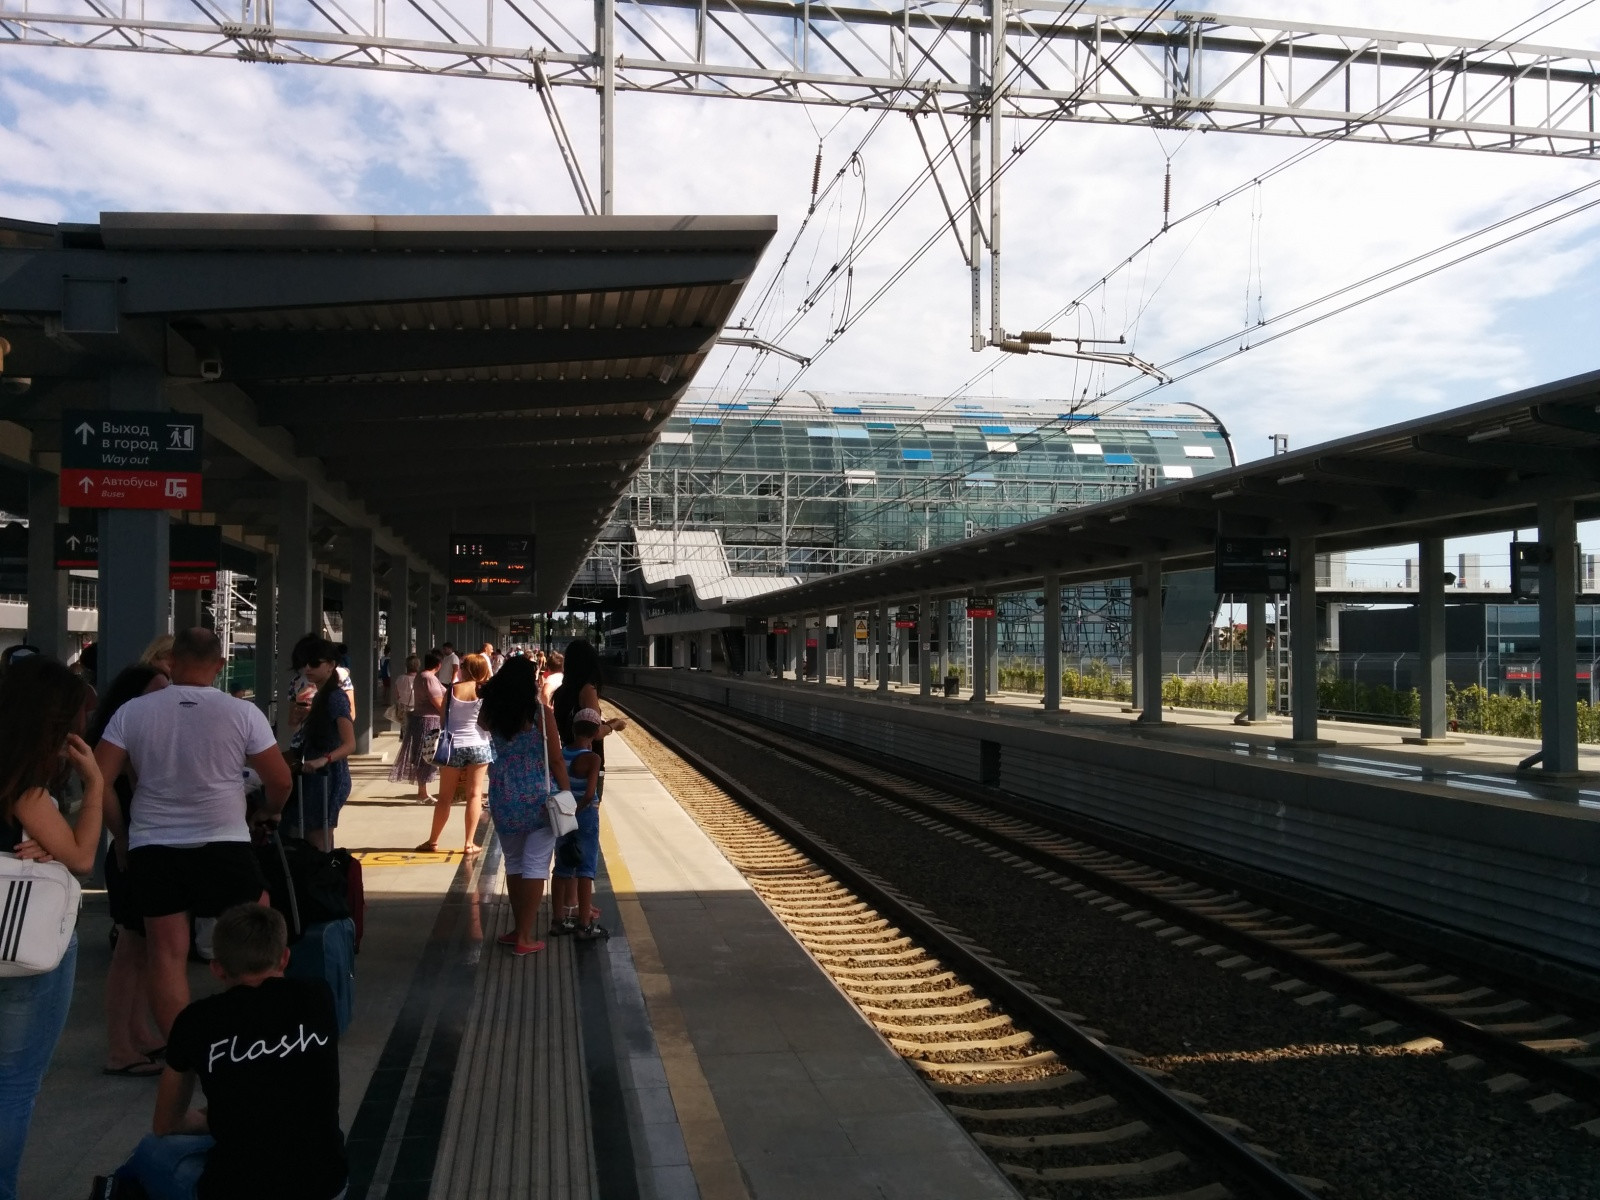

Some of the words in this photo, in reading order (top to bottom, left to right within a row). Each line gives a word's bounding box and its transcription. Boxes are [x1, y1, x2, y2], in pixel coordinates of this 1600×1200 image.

[102, 422, 150, 436] Выход
[102, 439, 110, 448] в
[114, 439, 159, 451] город
[102, 454, 128, 465] Way
[130, 455, 150, 464] out
[102, 476, 158, 488] Автобусы
[101, 490, 125, 498] Buses
[521, 540, 528, 551] 7
[208, 1024, 329, 1073] Flash
